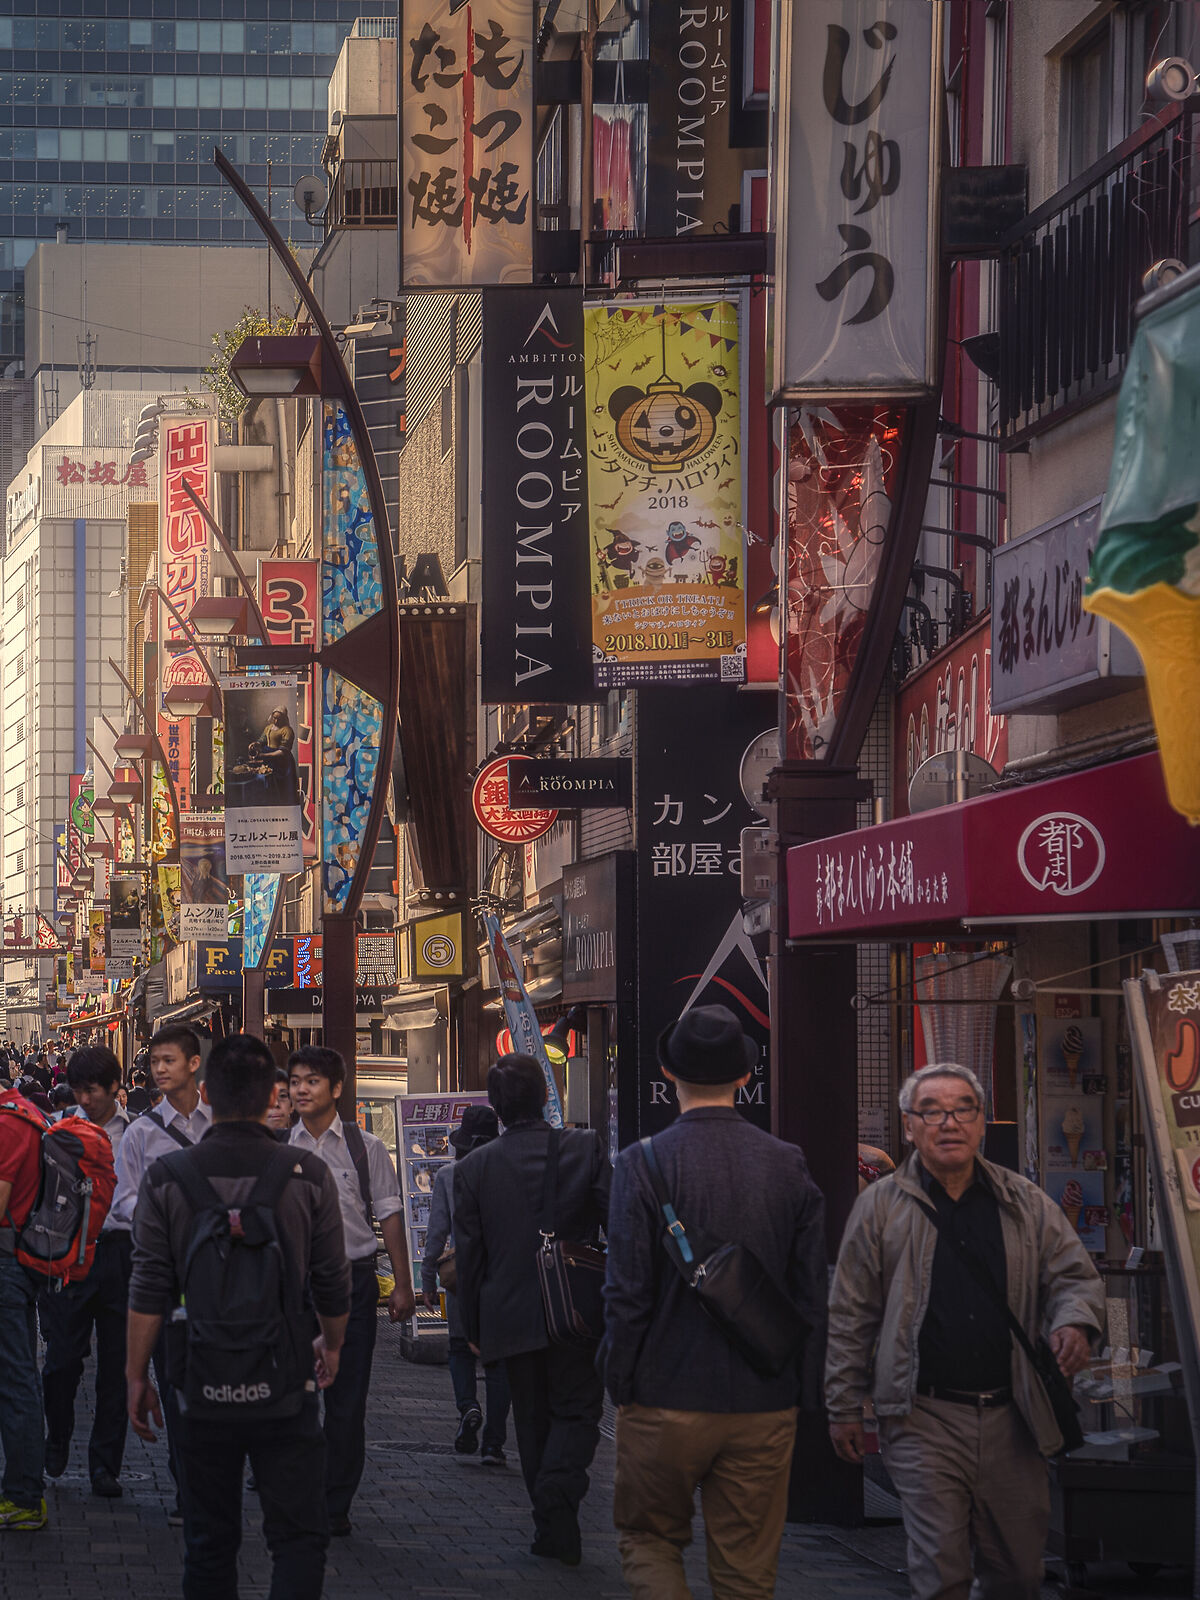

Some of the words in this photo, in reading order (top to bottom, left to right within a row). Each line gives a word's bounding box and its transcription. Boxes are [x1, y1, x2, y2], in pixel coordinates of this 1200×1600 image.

[710, 6, 729, 116] ルームピア
[408, 22, 466, 229] たこ焼
[469, 20, 529, 228] もつ焼
[676, 6, 704, 235] ROOMPIA
[508, 355, 585, 363] AMBITION
[560, 375, 584, 524] ルームピア
[606, 433, 647, 471] SHITAMACHI
[687, 433, 724, 470] HALLOWEEN
[56, 456, 149, 488] 松坂屋
[648, 496, 688, 509] 2018
[515, 374, 555, 687] ROOMPIA
[658, 595, 673, 605] OR
[264, 578, 315, 645] 3F
[706, 631, 725, 648] 31
[540, 779, 615, 791] ROOMPIA
[229, 831, 298, 842] フェルメール展
[184, 907, 224, 919] ムンク展
[205, 947, 229, 967] F
[266, 948, 289, 968] F
[432, 943, 447, 961] 5
[576, 931, 614, 972] ROOMPIA
[206, 967, 236, 976] Face
[406, 1104, 441, 1122] 上野
[203, 1382, 271, 1404] adidas
